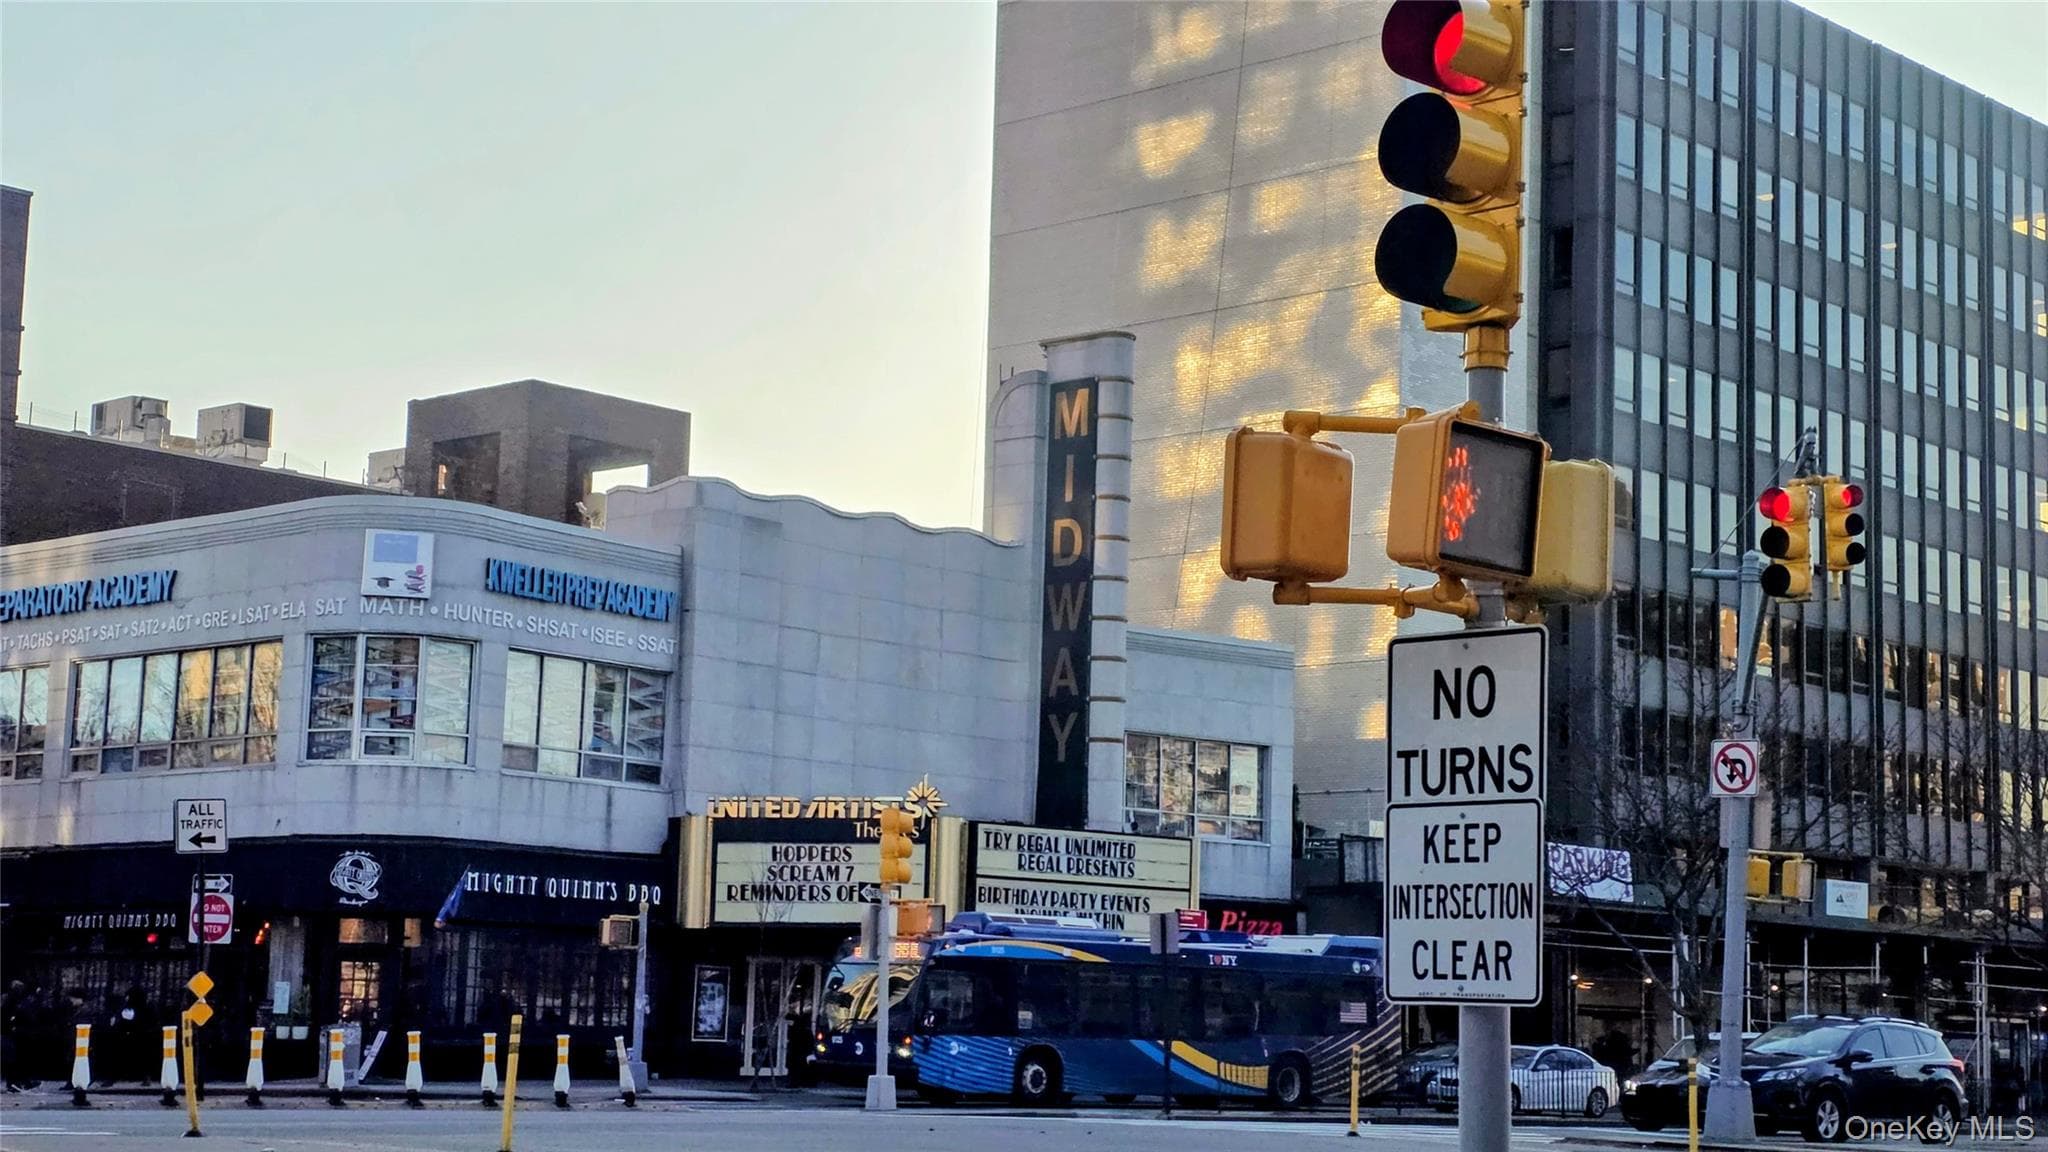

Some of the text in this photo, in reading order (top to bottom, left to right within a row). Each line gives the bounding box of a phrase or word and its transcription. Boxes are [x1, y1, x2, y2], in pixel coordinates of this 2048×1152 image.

[91, 570, 178, 609] ACADEMY
[487, 558, 677, 621] KWELLER PREP ACADEMY
[1048, 387, 1089, 762] MIDWAY
[18, 631, 53, 650] TACHS
[62, 626, 91, 645] PSAT
[100, 623, 122, 641] SAT
[130, 619, 159, 638] SAT2
[168, 614, 193, 632] ACT
[202, 610, 229, 628] GRE
[238, 604, 271, 625] LSAT
[281, 601, 306, 620] ELA
[315, 597, 346, 616] SAT
[360, 597, 425, 617] MATH
[444, 603, 513, 629] HUNTER
[526, 615, 579, 639] SHSAT
[590, 626, 625, 647] ISEE
[637, 634, 677, 655] SSAT
[1433, 665, 1496, 720] NO
[1397, 743, 1534, 797] TURNS
[188, 803, 215, 816] ALL
[708, 796, 801, 819] UNITED
[180, 819, 224, 830] TRAFFIC
[853, 821, 920, 838] Thes
[771, 845, 853, 863] HOPPERS
[983, 830, 1136, 860] TRY REGAL UNLIMITED
[1423, 822, 1502, 864] KEEP
[767, 864, 855, 882] SCREAM 7
[1017, 854, 1135, 879] REGAL PRESENTS
[466, 872, 661, 905] MIGHTY QUINN'S BBQ
[727, 883, 859, 902] REMINDERS OF
[978, 886, 1150, 913] BIRTHDAY PARTY EVENTS
[1392, 882, 1534, 920] INTERSECTION
[1220, 910, 1283, 936] Pizza
[1412, 939, 1512, 982] CLEAR
